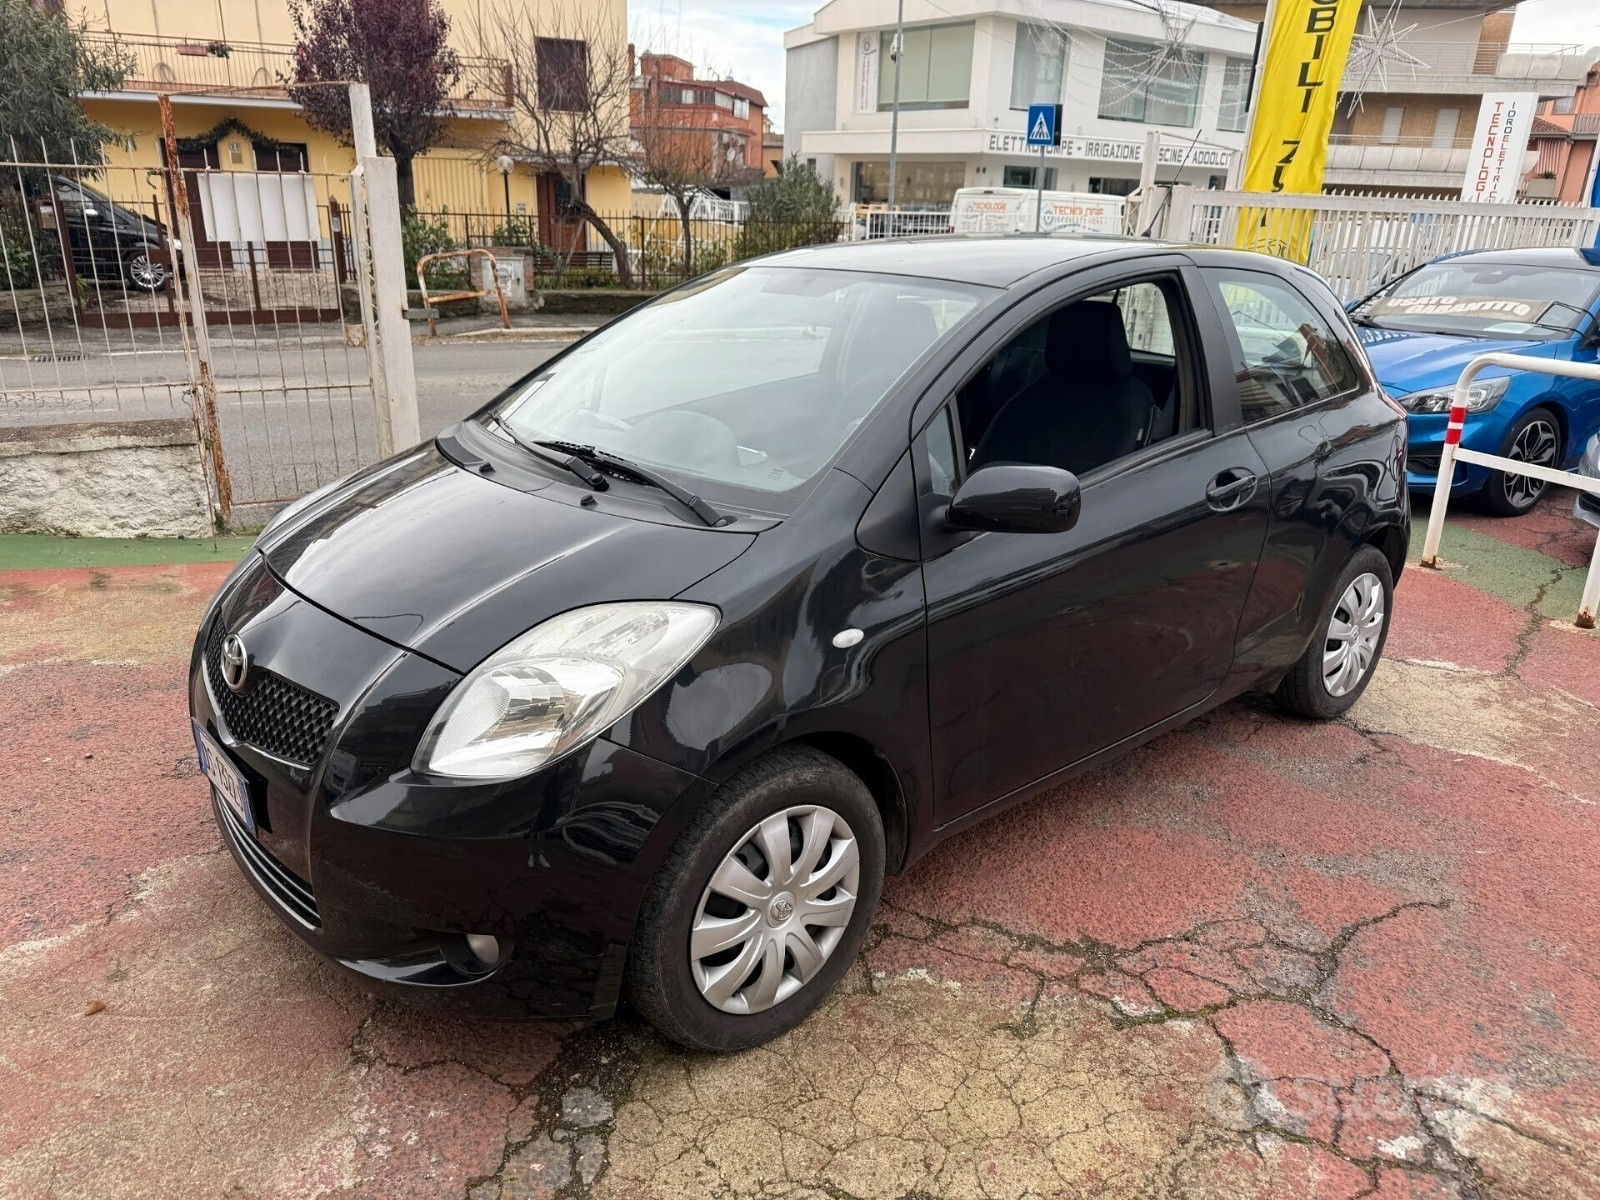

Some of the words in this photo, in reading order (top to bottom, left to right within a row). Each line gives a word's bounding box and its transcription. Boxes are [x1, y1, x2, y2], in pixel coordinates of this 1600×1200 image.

[1297, 0, 1337, 114] BILI
[1084, 141, 1141, 160] IRRIGAZIONE
[1158, 147, 1184, 163] SCINE
[1386, 296, 1458, 307] USATO
[1404, 300, 1531, 316] GARANTITO
